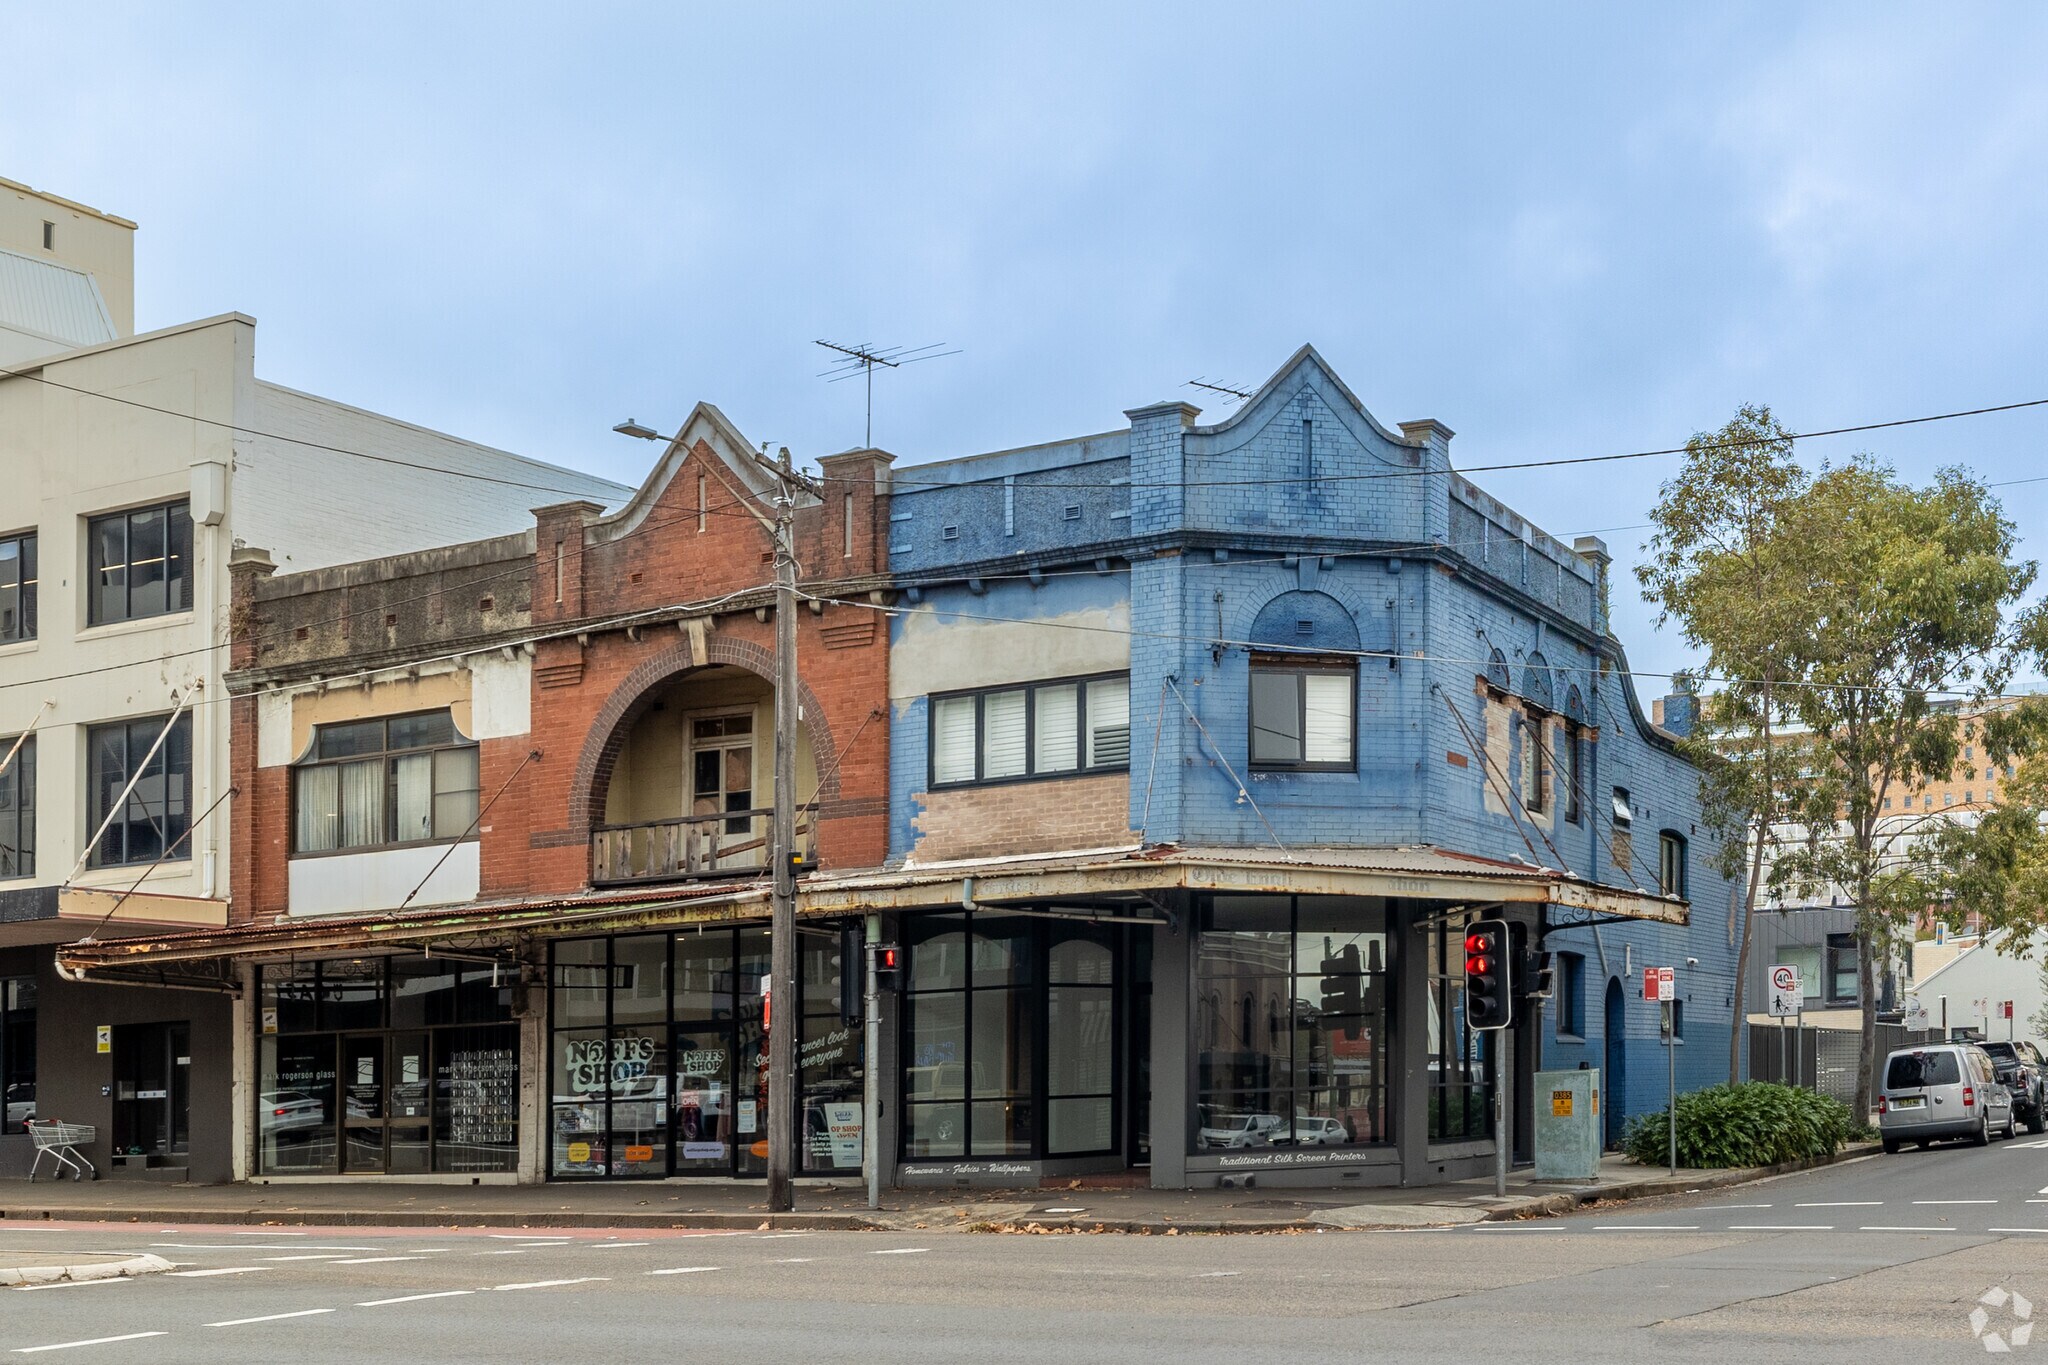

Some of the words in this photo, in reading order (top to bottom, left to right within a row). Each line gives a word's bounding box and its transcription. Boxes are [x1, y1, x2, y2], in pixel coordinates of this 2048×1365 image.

[1776, 973, 1790, 983] 40
[827, 1028, 850, 1045] look
[568, 1038, 655, 1063] NOFFS
[686, 1049, 725, 1061] NOFFS
[801, 1047, 843, 1068] everyone
[438, 1065, 457, 1074] mark
[689, 1060, 720, 1072] SHOP
[281, 1071, 314, 1081] rogerson
[315, 1069, 336, 1081] glass
[578, 1061, 646, 1085] SHOP
[831, 1125, 841, 1133] OP
[1219, 1155, 1272, 1166] Traditional
[1273, 1153, 1293, 1164] Silk
[1295, 1153, 1326, 1163] Screen
[1329, 1152, 1367, 1161] Printers
[904, 1165, 944, 1175] Homewares
[952, 1164, 980, 1175] Fabrics
[989, 1162, 1032, 1176] Wallpapers
